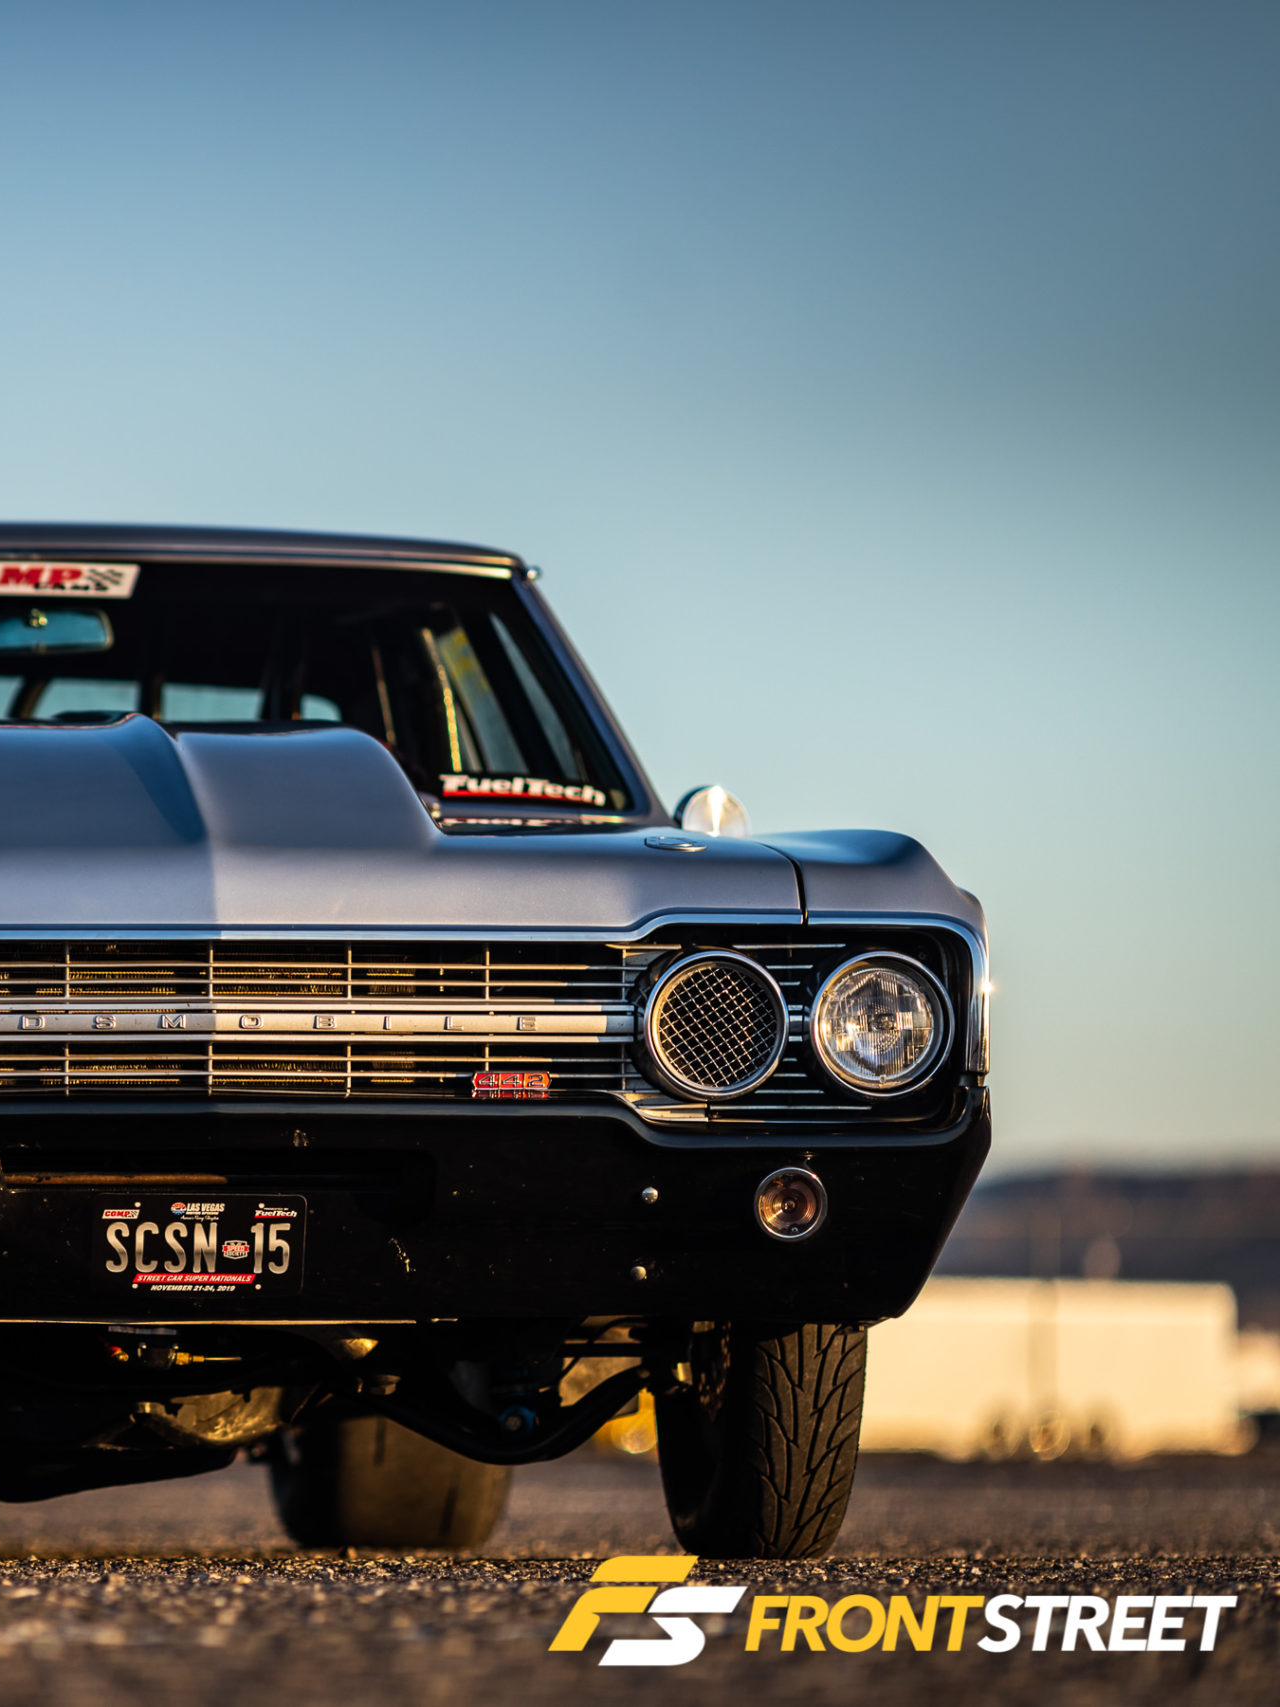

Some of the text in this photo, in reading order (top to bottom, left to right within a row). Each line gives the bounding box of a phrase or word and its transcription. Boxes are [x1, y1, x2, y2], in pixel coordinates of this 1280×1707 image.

[439, 774, 606, 806] FuelTech
[478, 1074, 546, 1088] 442
[187, 1203, 225, 1212] LAS VEGAS
[105, 1221, 291, 1275] SCSN 15
